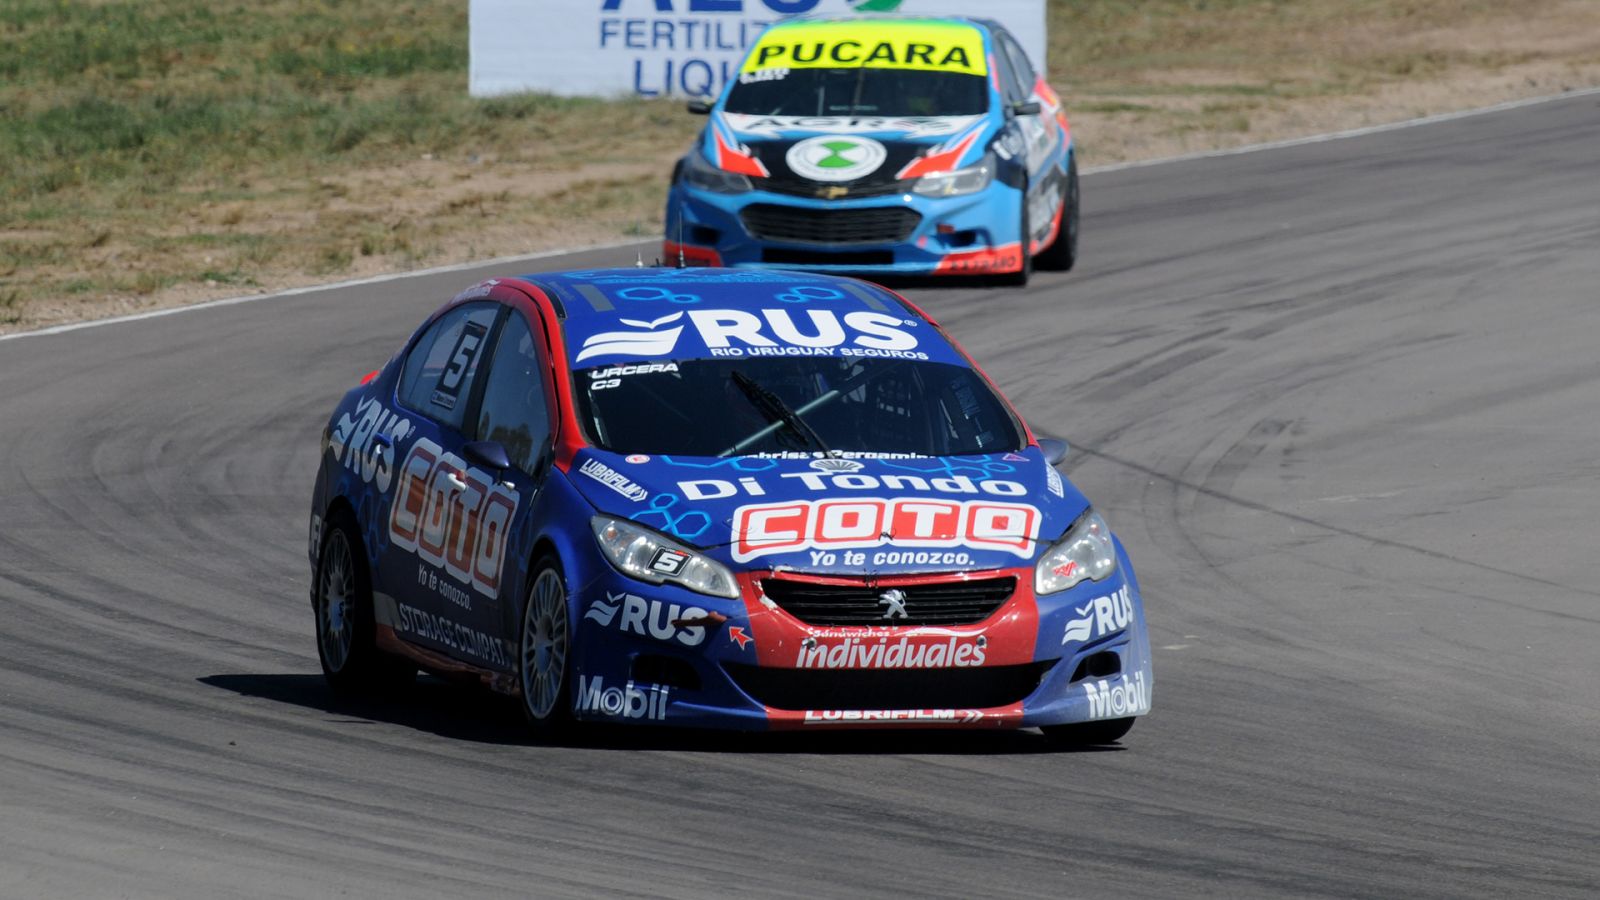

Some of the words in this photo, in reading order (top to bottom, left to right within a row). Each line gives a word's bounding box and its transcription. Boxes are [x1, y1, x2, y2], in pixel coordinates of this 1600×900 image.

[757, 41, 971, 68] PUCARA
[687, 308, 919, 352] RUS
[443, 333, 481, 389] 5
[591, 362, 679, 379] URCERA
[710, 347, 743, 357] RIO
[747, 346, 835, 357] URUGUAY
[841, 348, 930, 361] SEGUROS
[591, 378, 622, 390] C3
[344, 399, 411, 494] RUS
[579, 457, 643, 498] LUBRIFILM
[677, 476, 766, 501] Di
[780, 471, 1028, 497] Tondo
[389, 436, 521, 600] COTO
[732, 498, 1041, 563] COTO
[653, 551, 685, 572] 5
[809, 550, 833, 566] Yo
[843, 550, 866, 566] te
[873, 552, 976, 566] conozco.
[418, 563, 427, 585] Yo
[429, 571, 437, 591] te
[439, 578, 472, 611] conozco.
[619, 593, 709, 647] RUS
[1093, 583, 1134, 637] RUS
[796, 636, 986, 669] individuales
[812, 626, 890, 639] Sandwiches
[574, 674, 670, 721] Mobil
[804, 708, 956, 721] LUBRIFILM
[1082, 670, 1148, 719] Mobil
